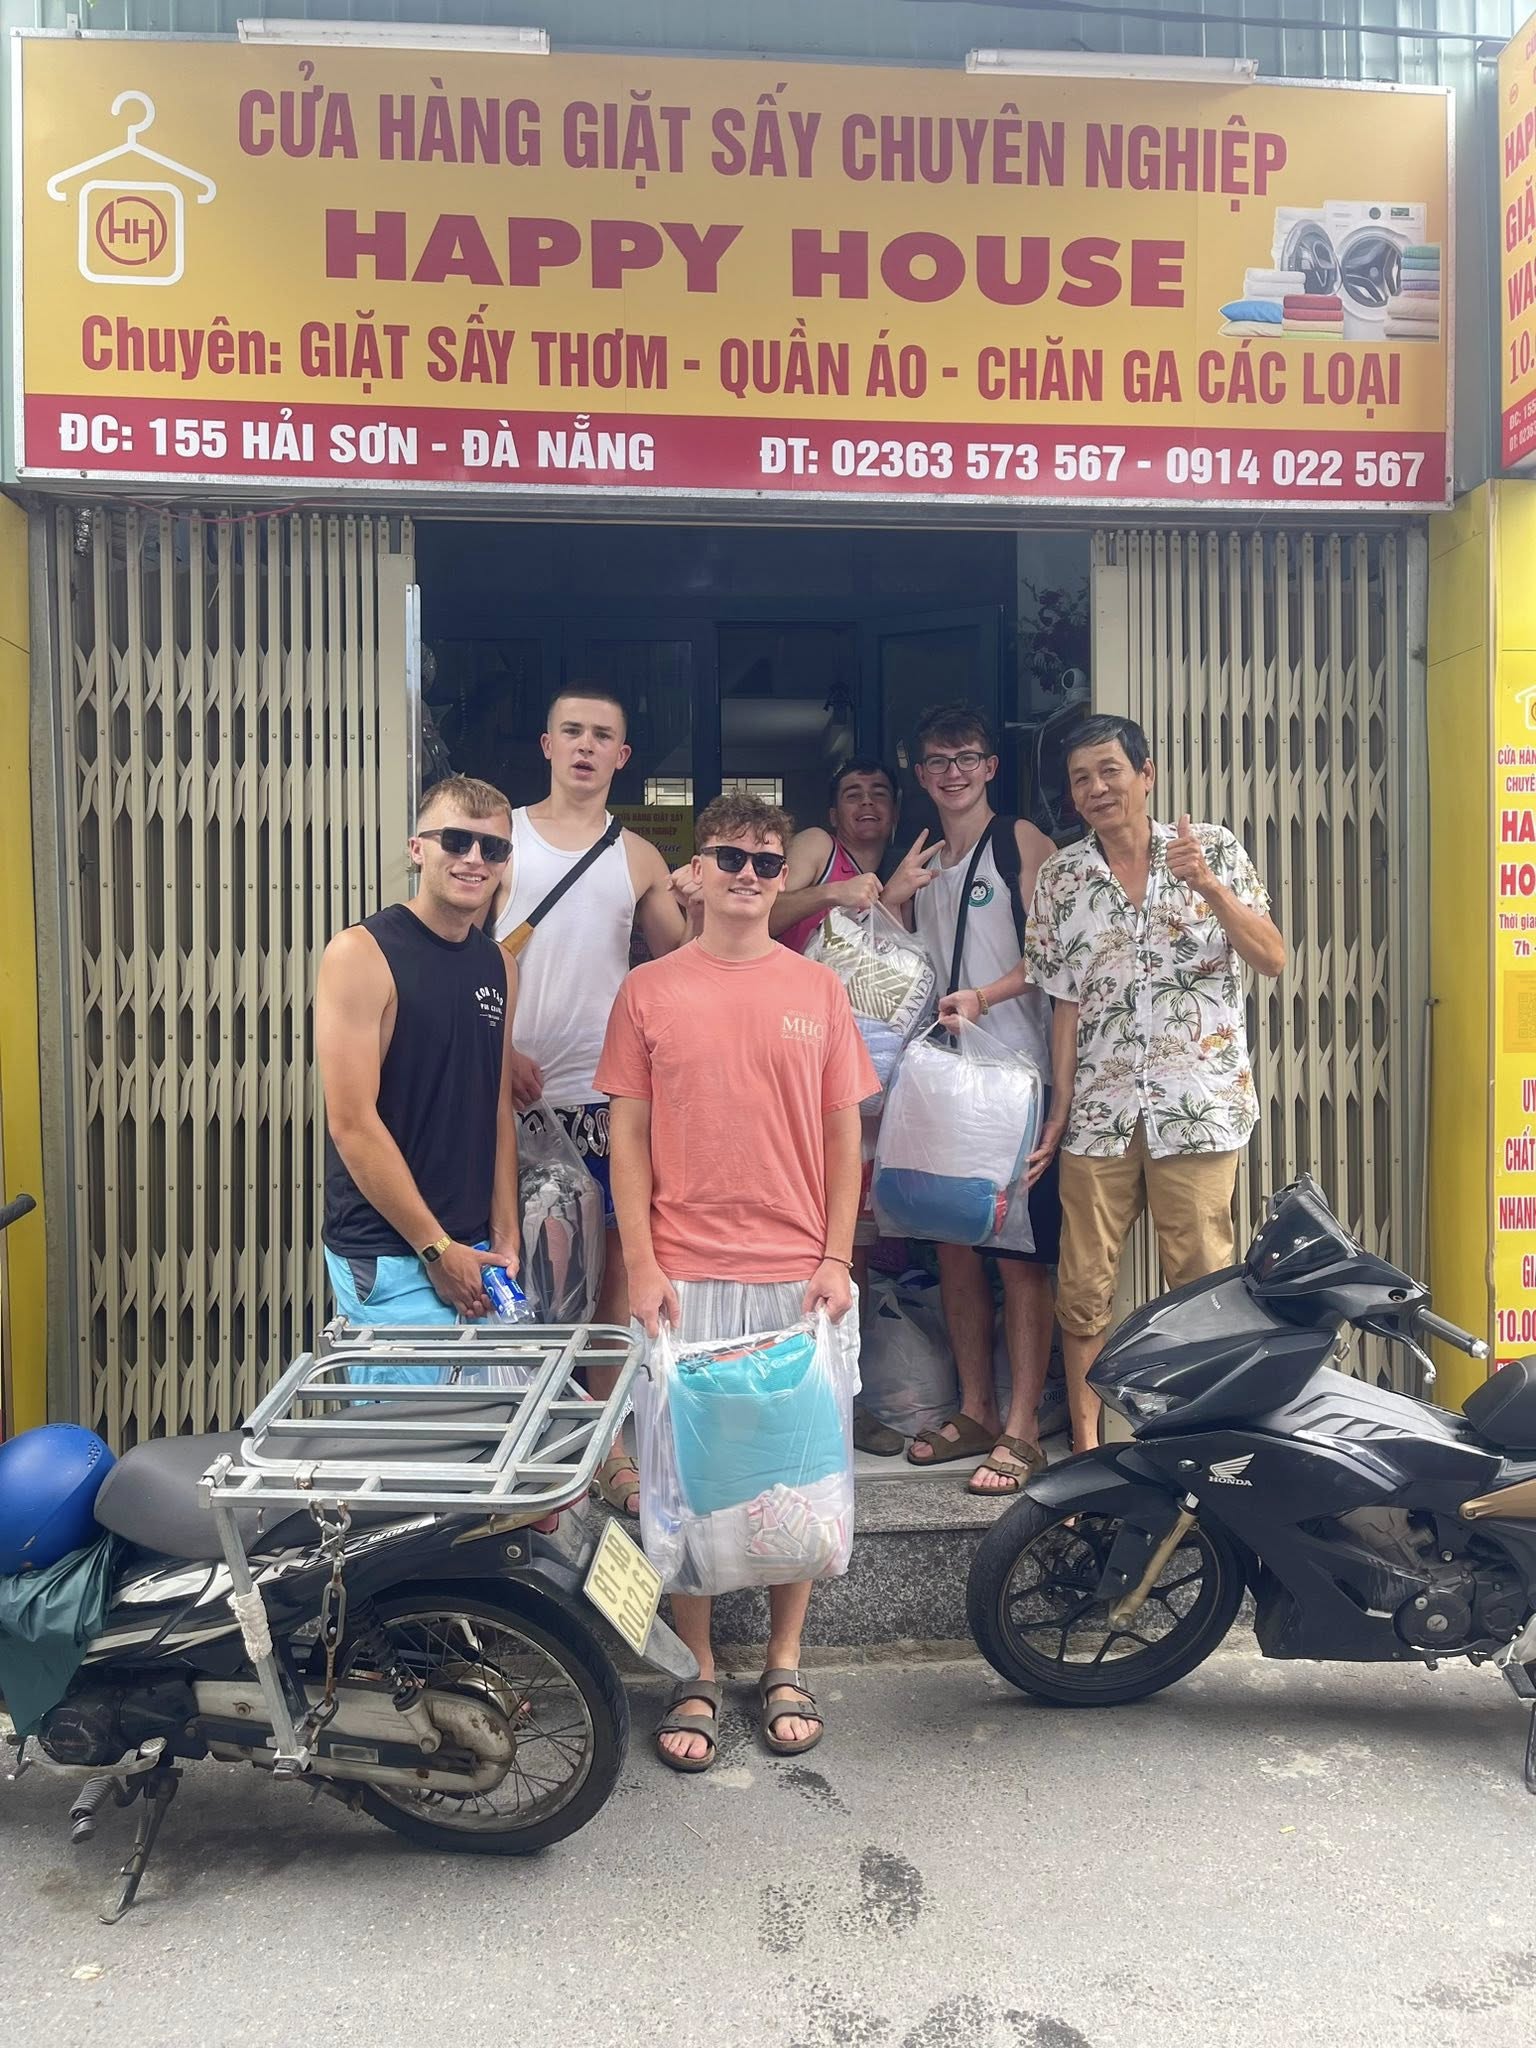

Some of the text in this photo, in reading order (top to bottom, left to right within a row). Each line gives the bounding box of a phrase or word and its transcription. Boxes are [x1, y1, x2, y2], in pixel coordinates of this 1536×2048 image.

[239, 61, 1288, 212] CỬA HÀNG GIẶT SẤY CHUYÊN NGHIỆP
[1505, 107, 1536, 178] HAP
[325, 208, 1184, 308] HAPPY HOUSE
[1508, 257, 1536, 321] WA
[82, 303, 1402, 418] Chuyên: GIẶT SẤY THƠM - QUẦN ÁO - CHĂN GA CÁC LOẠI
[59, 408, 655, 471] ĐC: 155 HẢI SƠN - ĐÀ NẴNG
[760, 437, 1425, 487] ĐT: 02363 573 567 - 0914 022 567
[1208, 1475, 1253, 1487] HONDA
